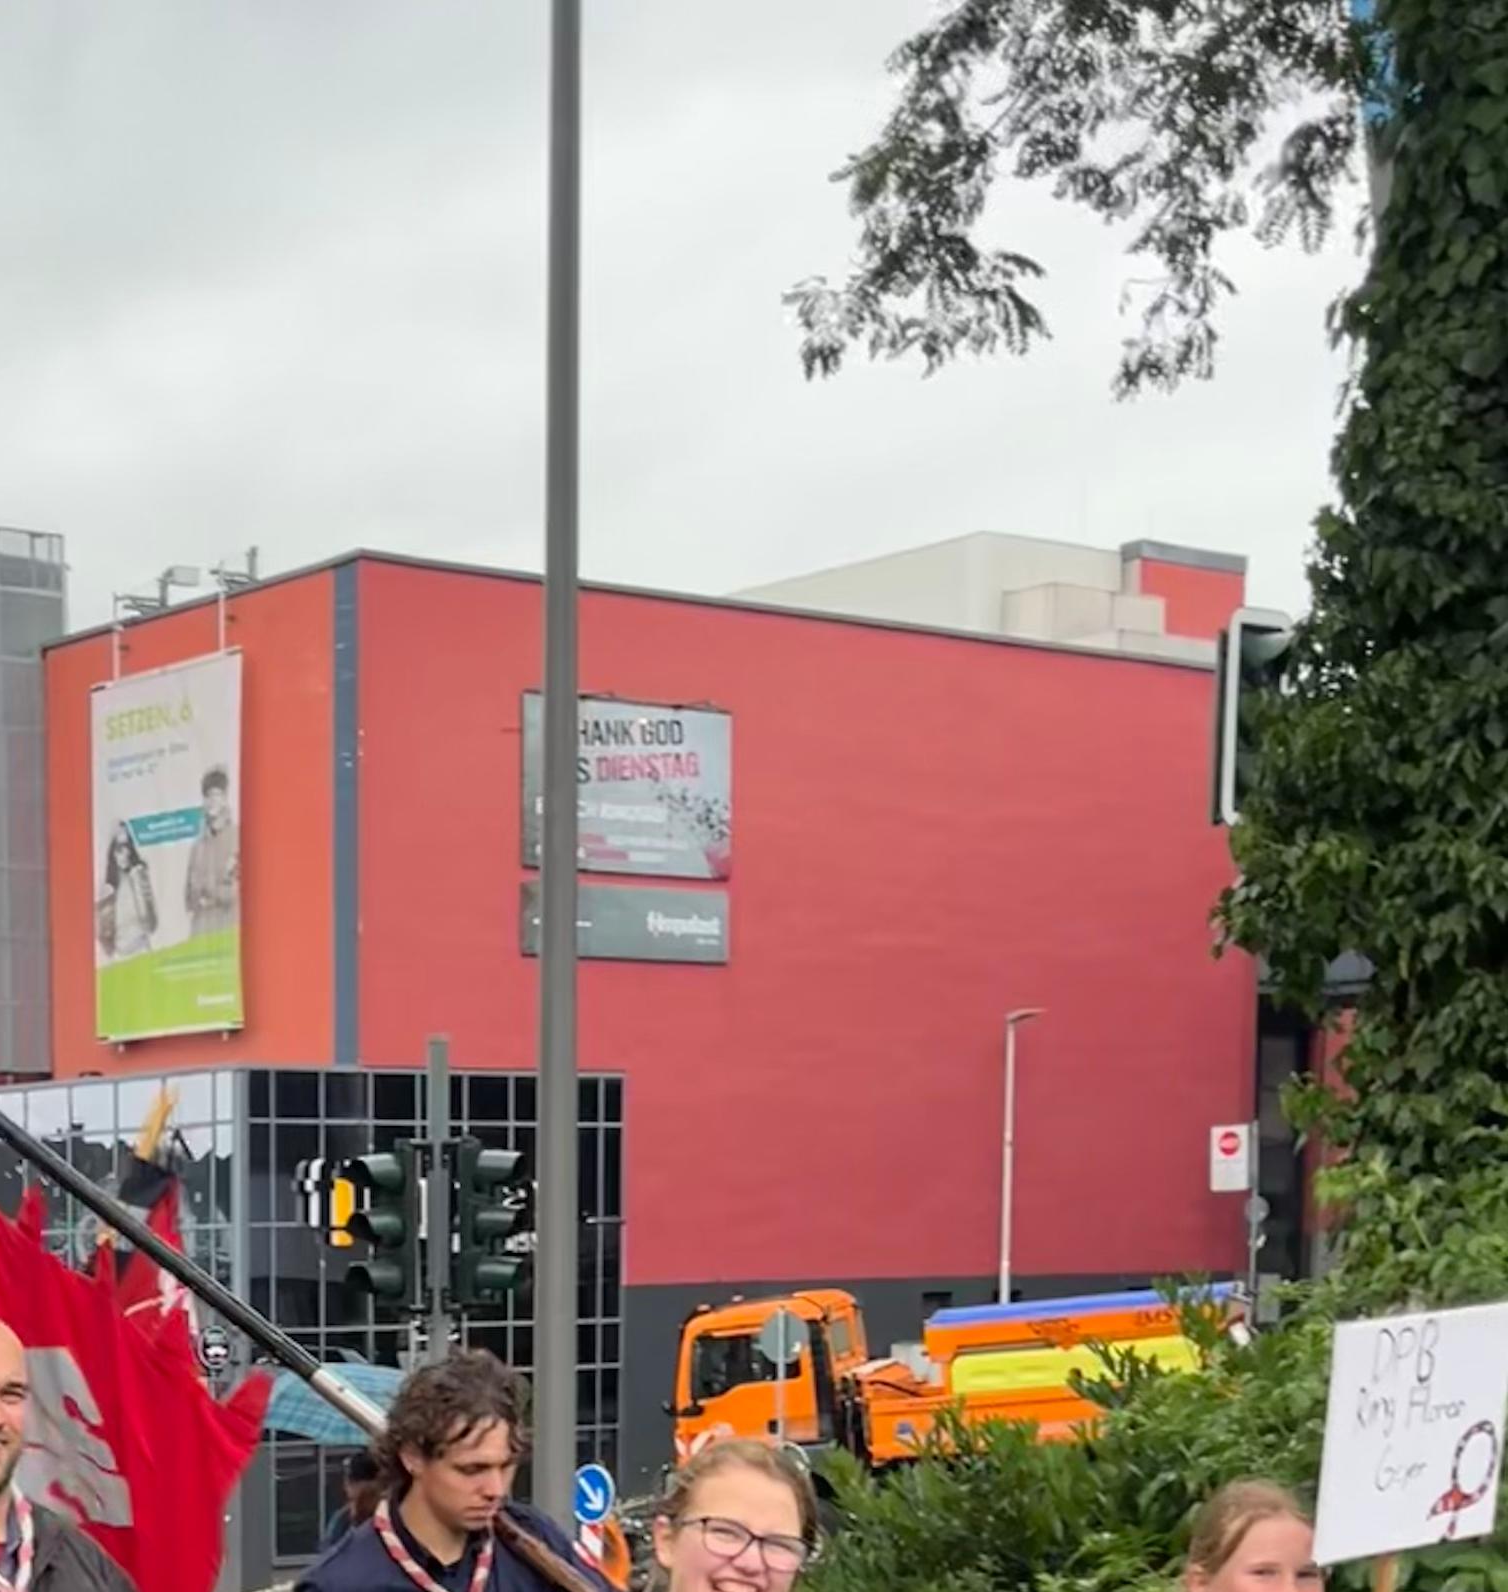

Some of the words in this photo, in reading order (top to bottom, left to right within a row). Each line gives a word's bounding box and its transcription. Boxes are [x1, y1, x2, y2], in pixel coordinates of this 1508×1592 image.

[577, 718, 636, 746] HANK
[639, 718, 685, 746] GOD
[596, 751, 700, 783] DIENSTAG
